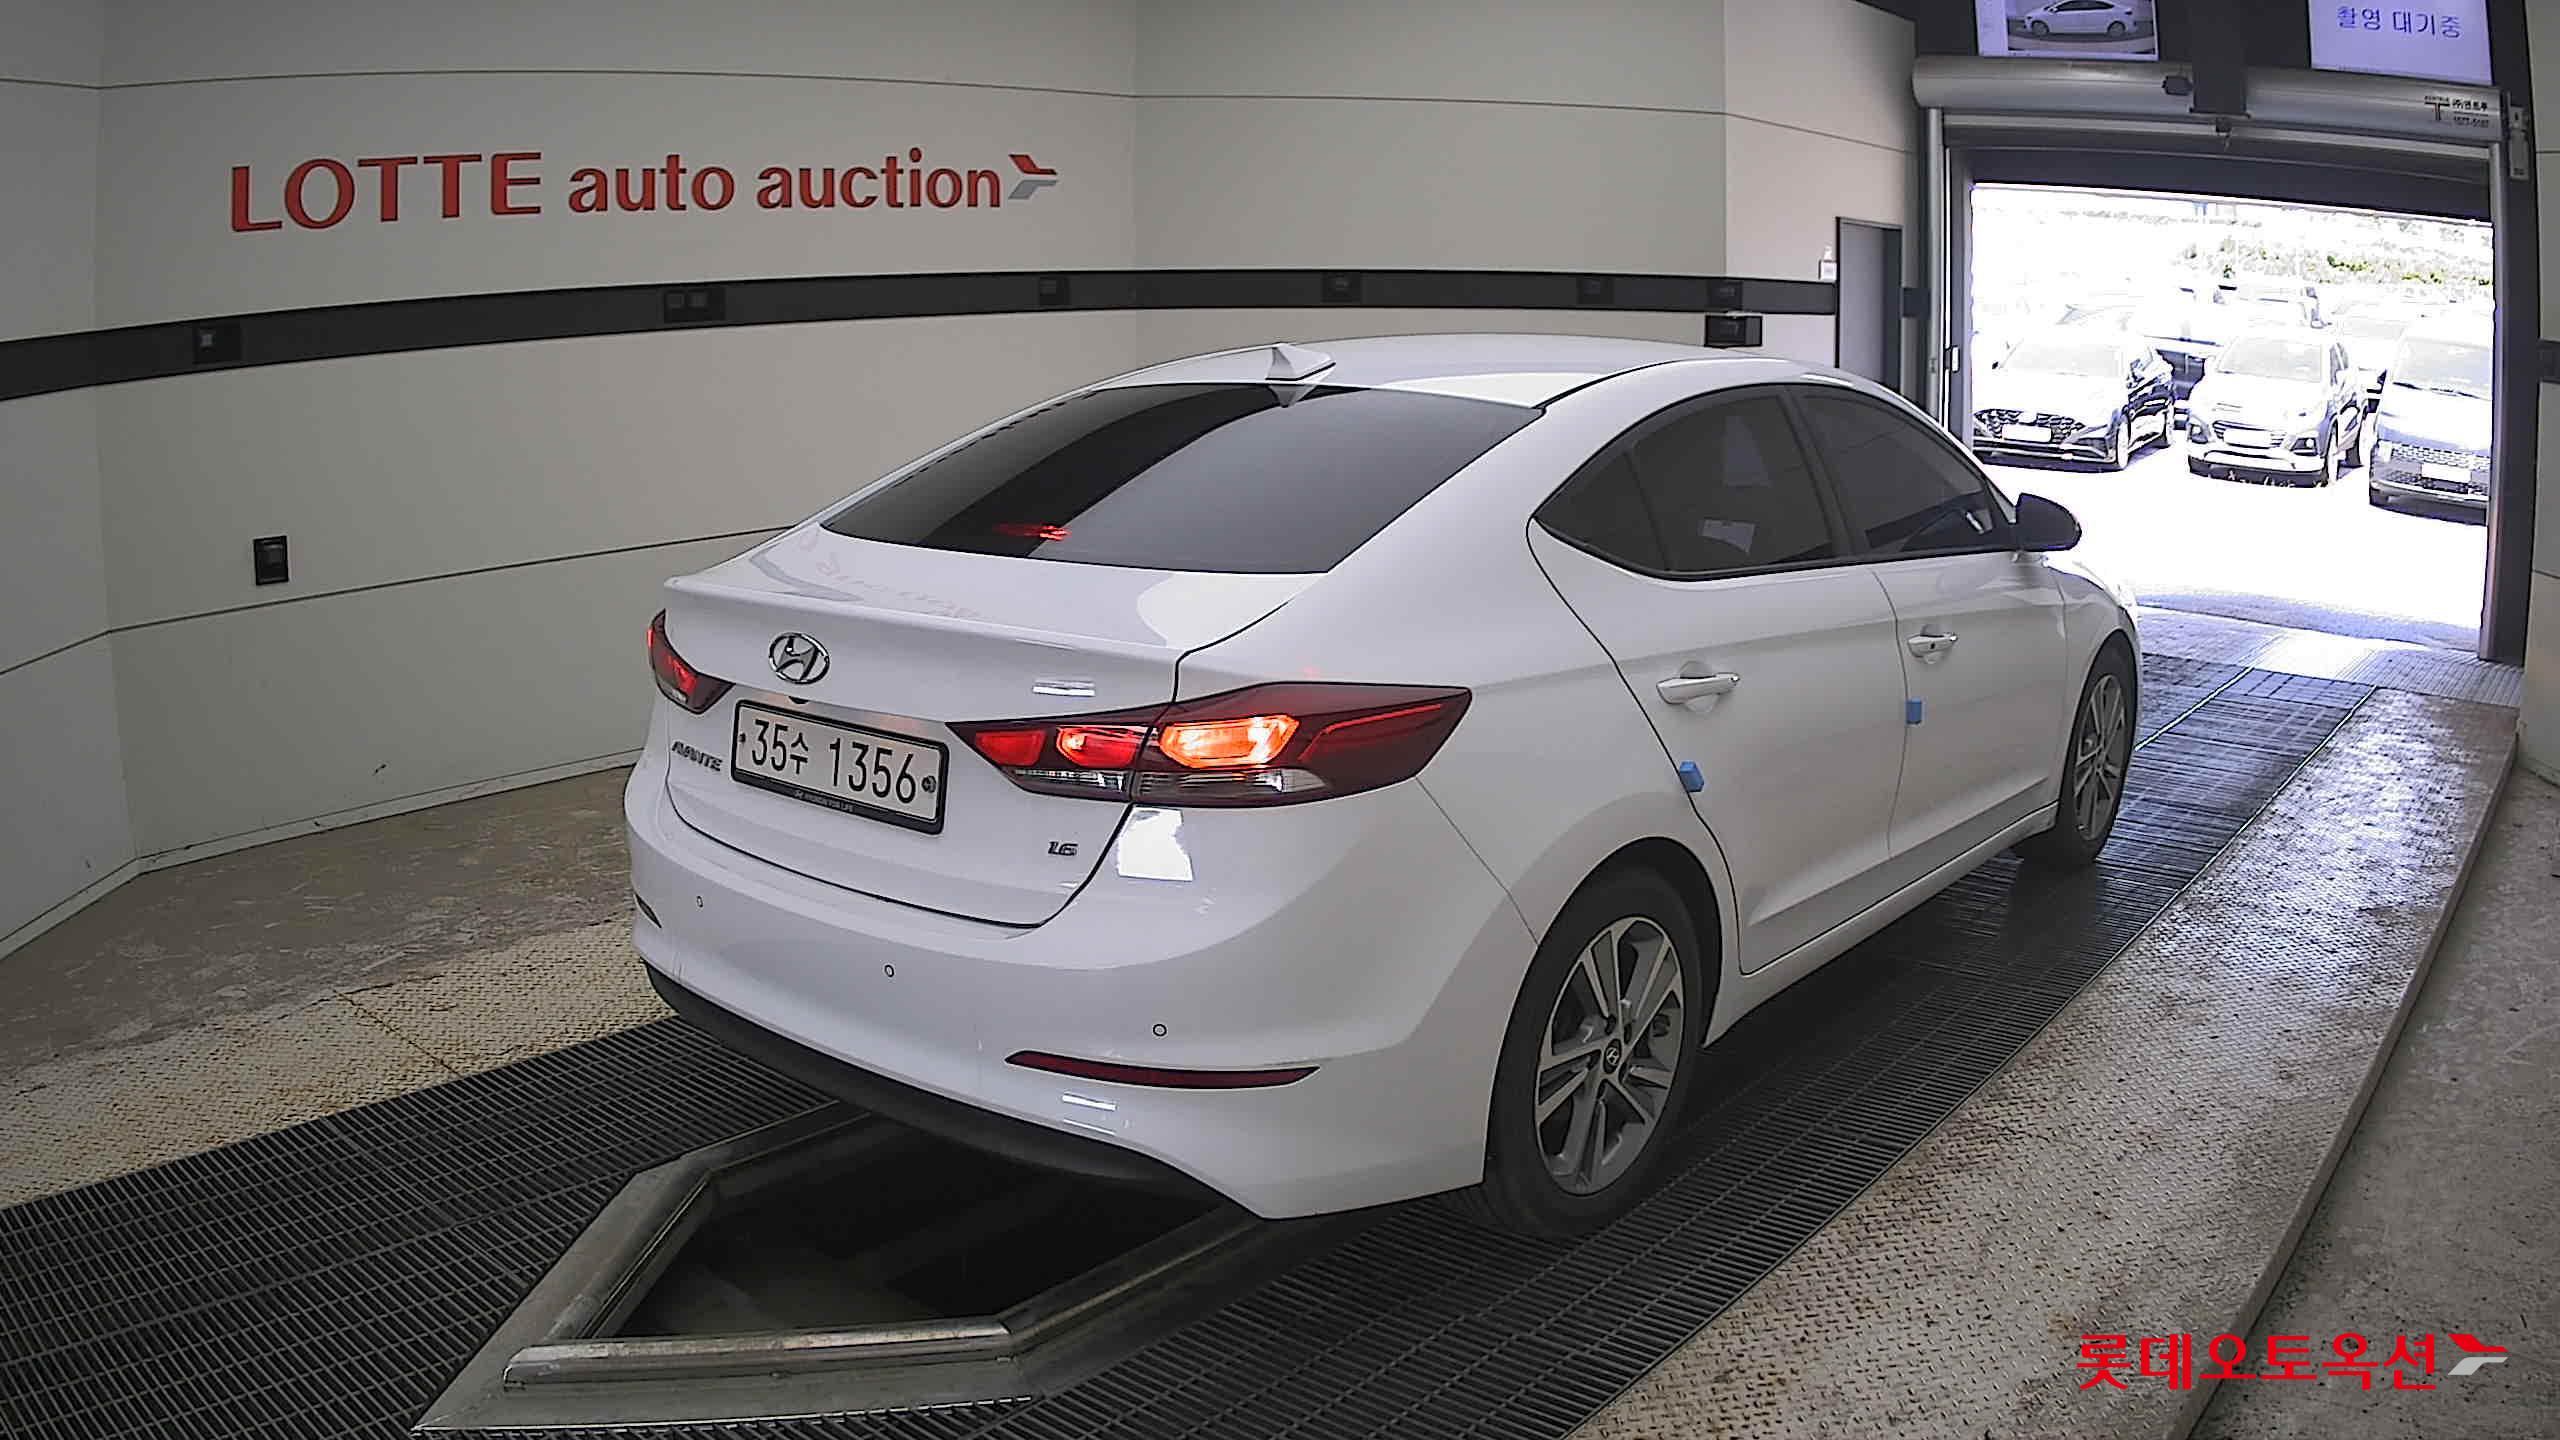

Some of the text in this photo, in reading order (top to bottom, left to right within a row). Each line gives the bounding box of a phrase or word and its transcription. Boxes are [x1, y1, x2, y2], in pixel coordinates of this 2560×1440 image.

[2392, 10, 2461, 39] 대기중
[231, 148, 1001, 232] LOTTE auto auction
[751, 718, 917, 804] 35수 1356
